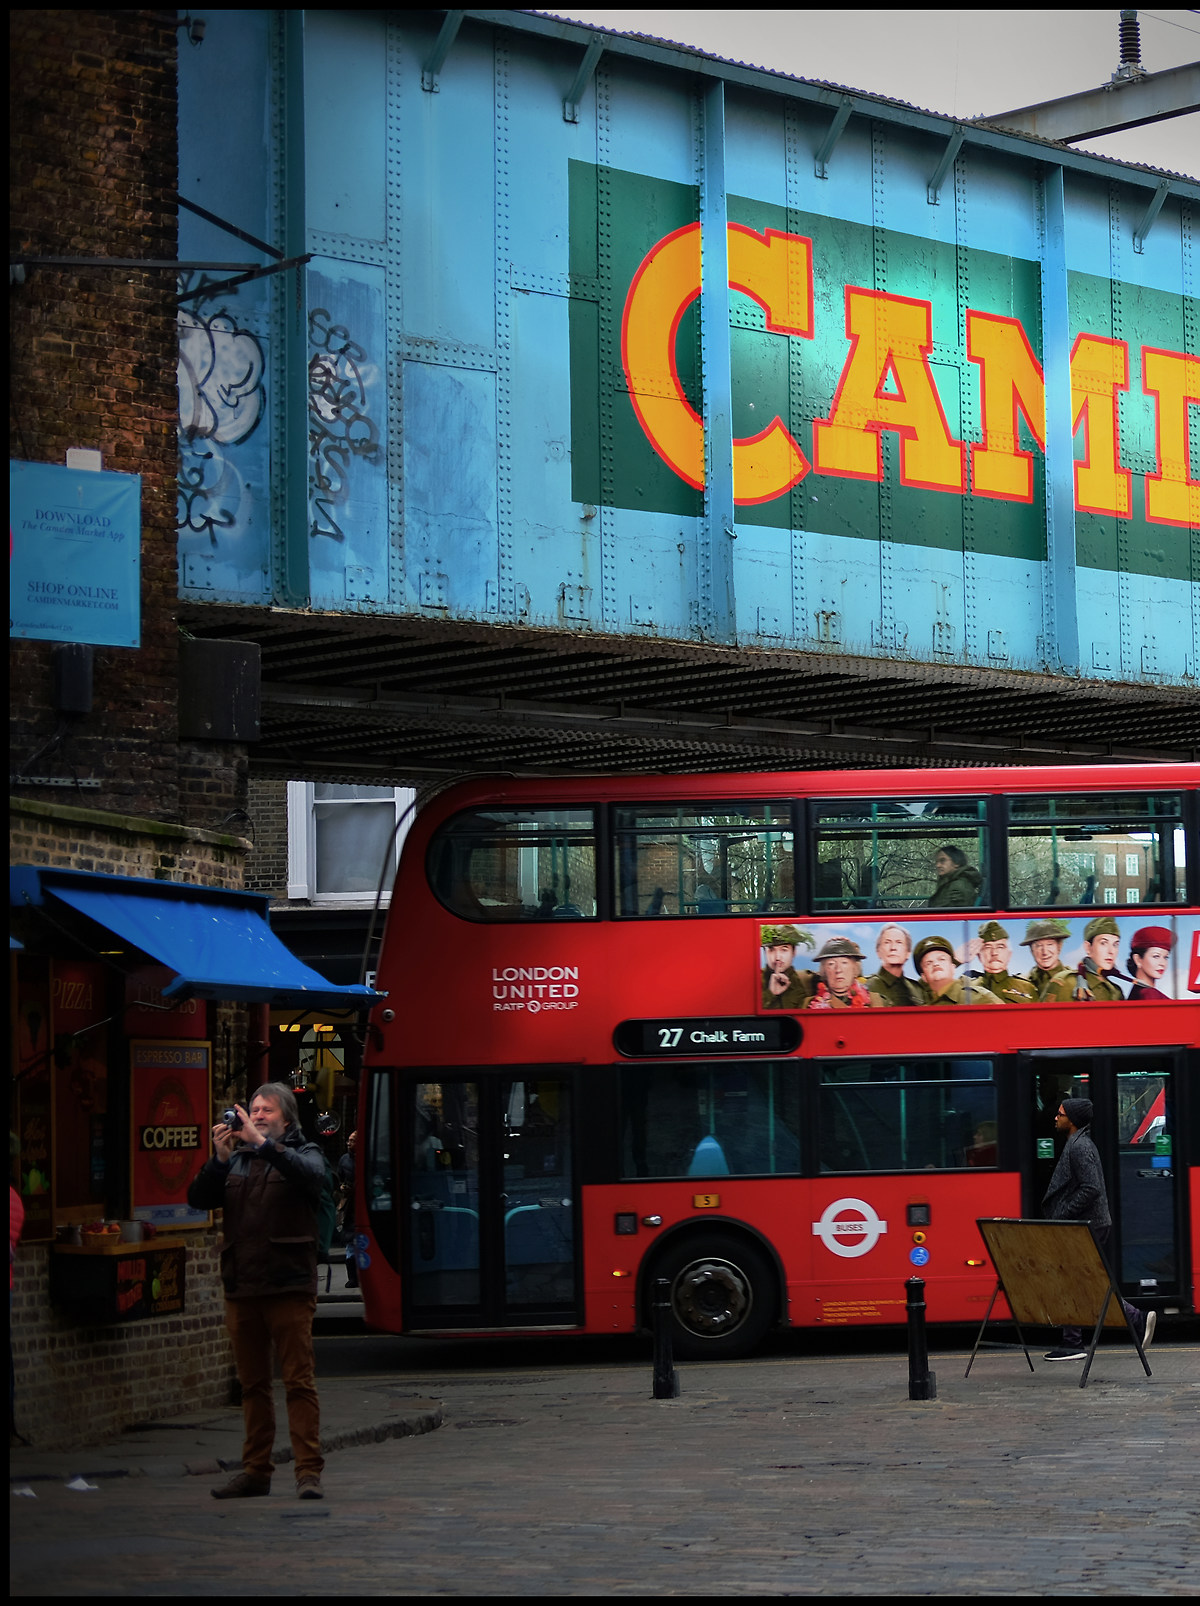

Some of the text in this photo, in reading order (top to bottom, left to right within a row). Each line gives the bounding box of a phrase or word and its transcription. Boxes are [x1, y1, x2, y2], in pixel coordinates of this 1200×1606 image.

[35, 509, 112, 528] DOWNLOAD
[22, 520, 125, 542] The Camden Market App
[27, 581, 119, 601] SHOP ONLINE
[493, 967, 579, 981] LONDON
[51, 977, 94, 1010] PIZZA
[493, 984, 579, 999] UNITED
[493, 1001, 579, 1011] RATP GROUP
[658, 1028, 765, 1047] 27 Chalk Farm
[136, 1049, 203, 1064] ESPRESSO BAR
[143, 1126, 198, 1149] COFFEE
[836, 1224, 863, 1232] BUSES
